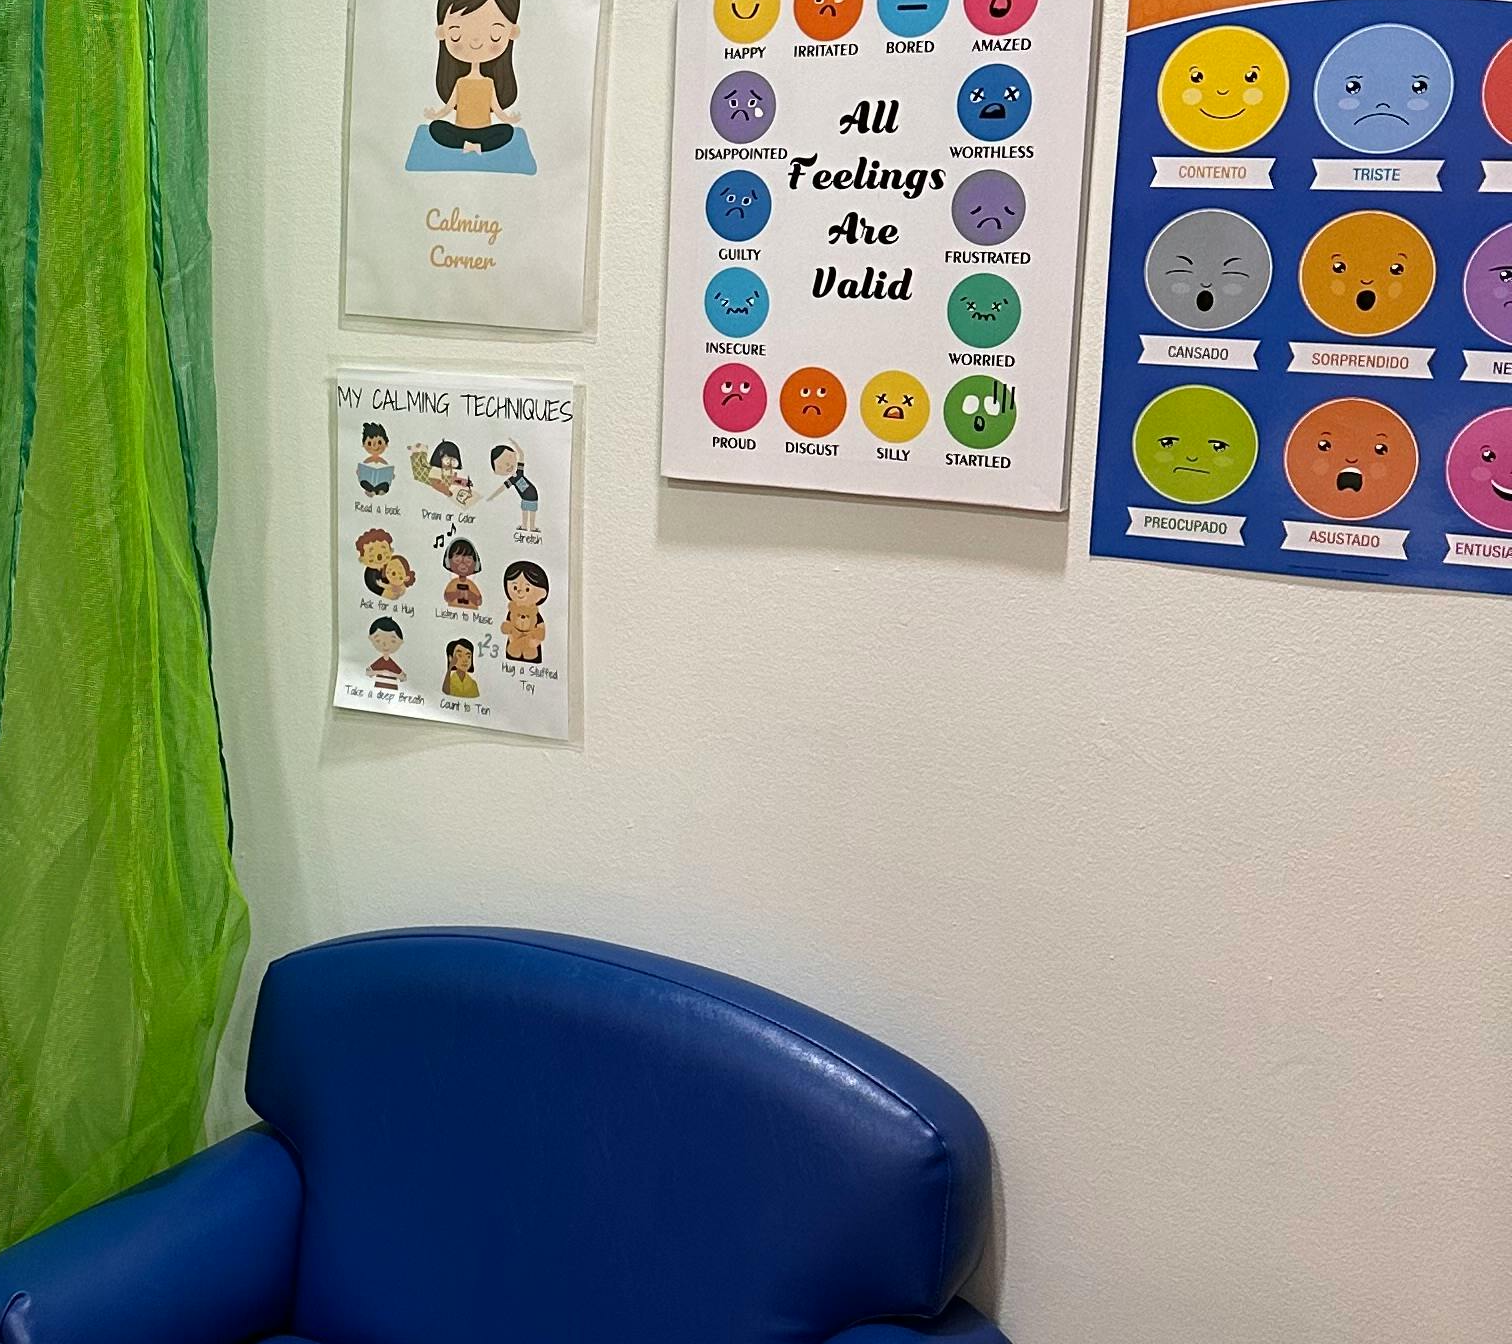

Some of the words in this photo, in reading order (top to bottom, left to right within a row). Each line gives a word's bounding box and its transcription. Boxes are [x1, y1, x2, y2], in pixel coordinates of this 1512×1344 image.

[723, 46, 767, 60] HAPPY
[793, 43, 859, 58] IRRITATED
[885, 40, 936, 55] BORED
[971, 37, 1032, 53] AMAZED
[838, 99, 901, 135] All
[694, 147, 788, 161] DISAPPOINTED
[949, 145, 1035, 160] WORTHLESS
[787, 152, 947, 200] Feelings
[1178, 165, 1248, 180] CONTENTO
[1352, 168, 1402, 182] TRISTE
[425, 207, 503, 246] Calming
[827, 211, 900, 246] Are
[428, 244, 496, 271] Corner
[718, 248, 762, 261] GUILTY
[944, 250, 1031, 265] FRUSTRATED
[811, 266, 914, 301] Valid
[705, 342, 767, 357] INSECURE
[1167, 345, 1230, 361] CANSADO
[948, 353, 1016, 368] WORRIED
[1311, 353, 1410, 370] SORPRENDIDO
[337, 385, 363, 408] MY
[372, 389, 451, 418] CALMING
[460, 393, 574, 423] TECHNIQUES
[712, 436, 757, 451] PROUD
[785, 441, 840, 457] DISGUST
[876, 447, 912, 462] SILLY
[945, 453, 1012, 470] STARTLED
[354, 501, 373, 513] Read
[384, 505, 401, 516] book
[421, 508, 442, 521] Draw
[445, 514, 455, 522] or
[458, 513, 476, 524] Color
[1143, 516, 1228, 535] PREOCUPADO
[513, 532, 543, 545] Stretch
[1308, 530, 1381, 549] ASUSTADO
[360, 598, 374, 609] Ask
[378, 600, 389, 611] for
[401, 603, 415, 617] Hug
[501, 662, 516, 677] Hug
[528, 665, 559, 680] Stuffed
[345, 684, 365, 697] Take
[519, 680, 536, 696] Toy
[440, 698, 460, 711] Count
[463, 702, 471, 713] to
[475, 704, 491, 716] Ten
